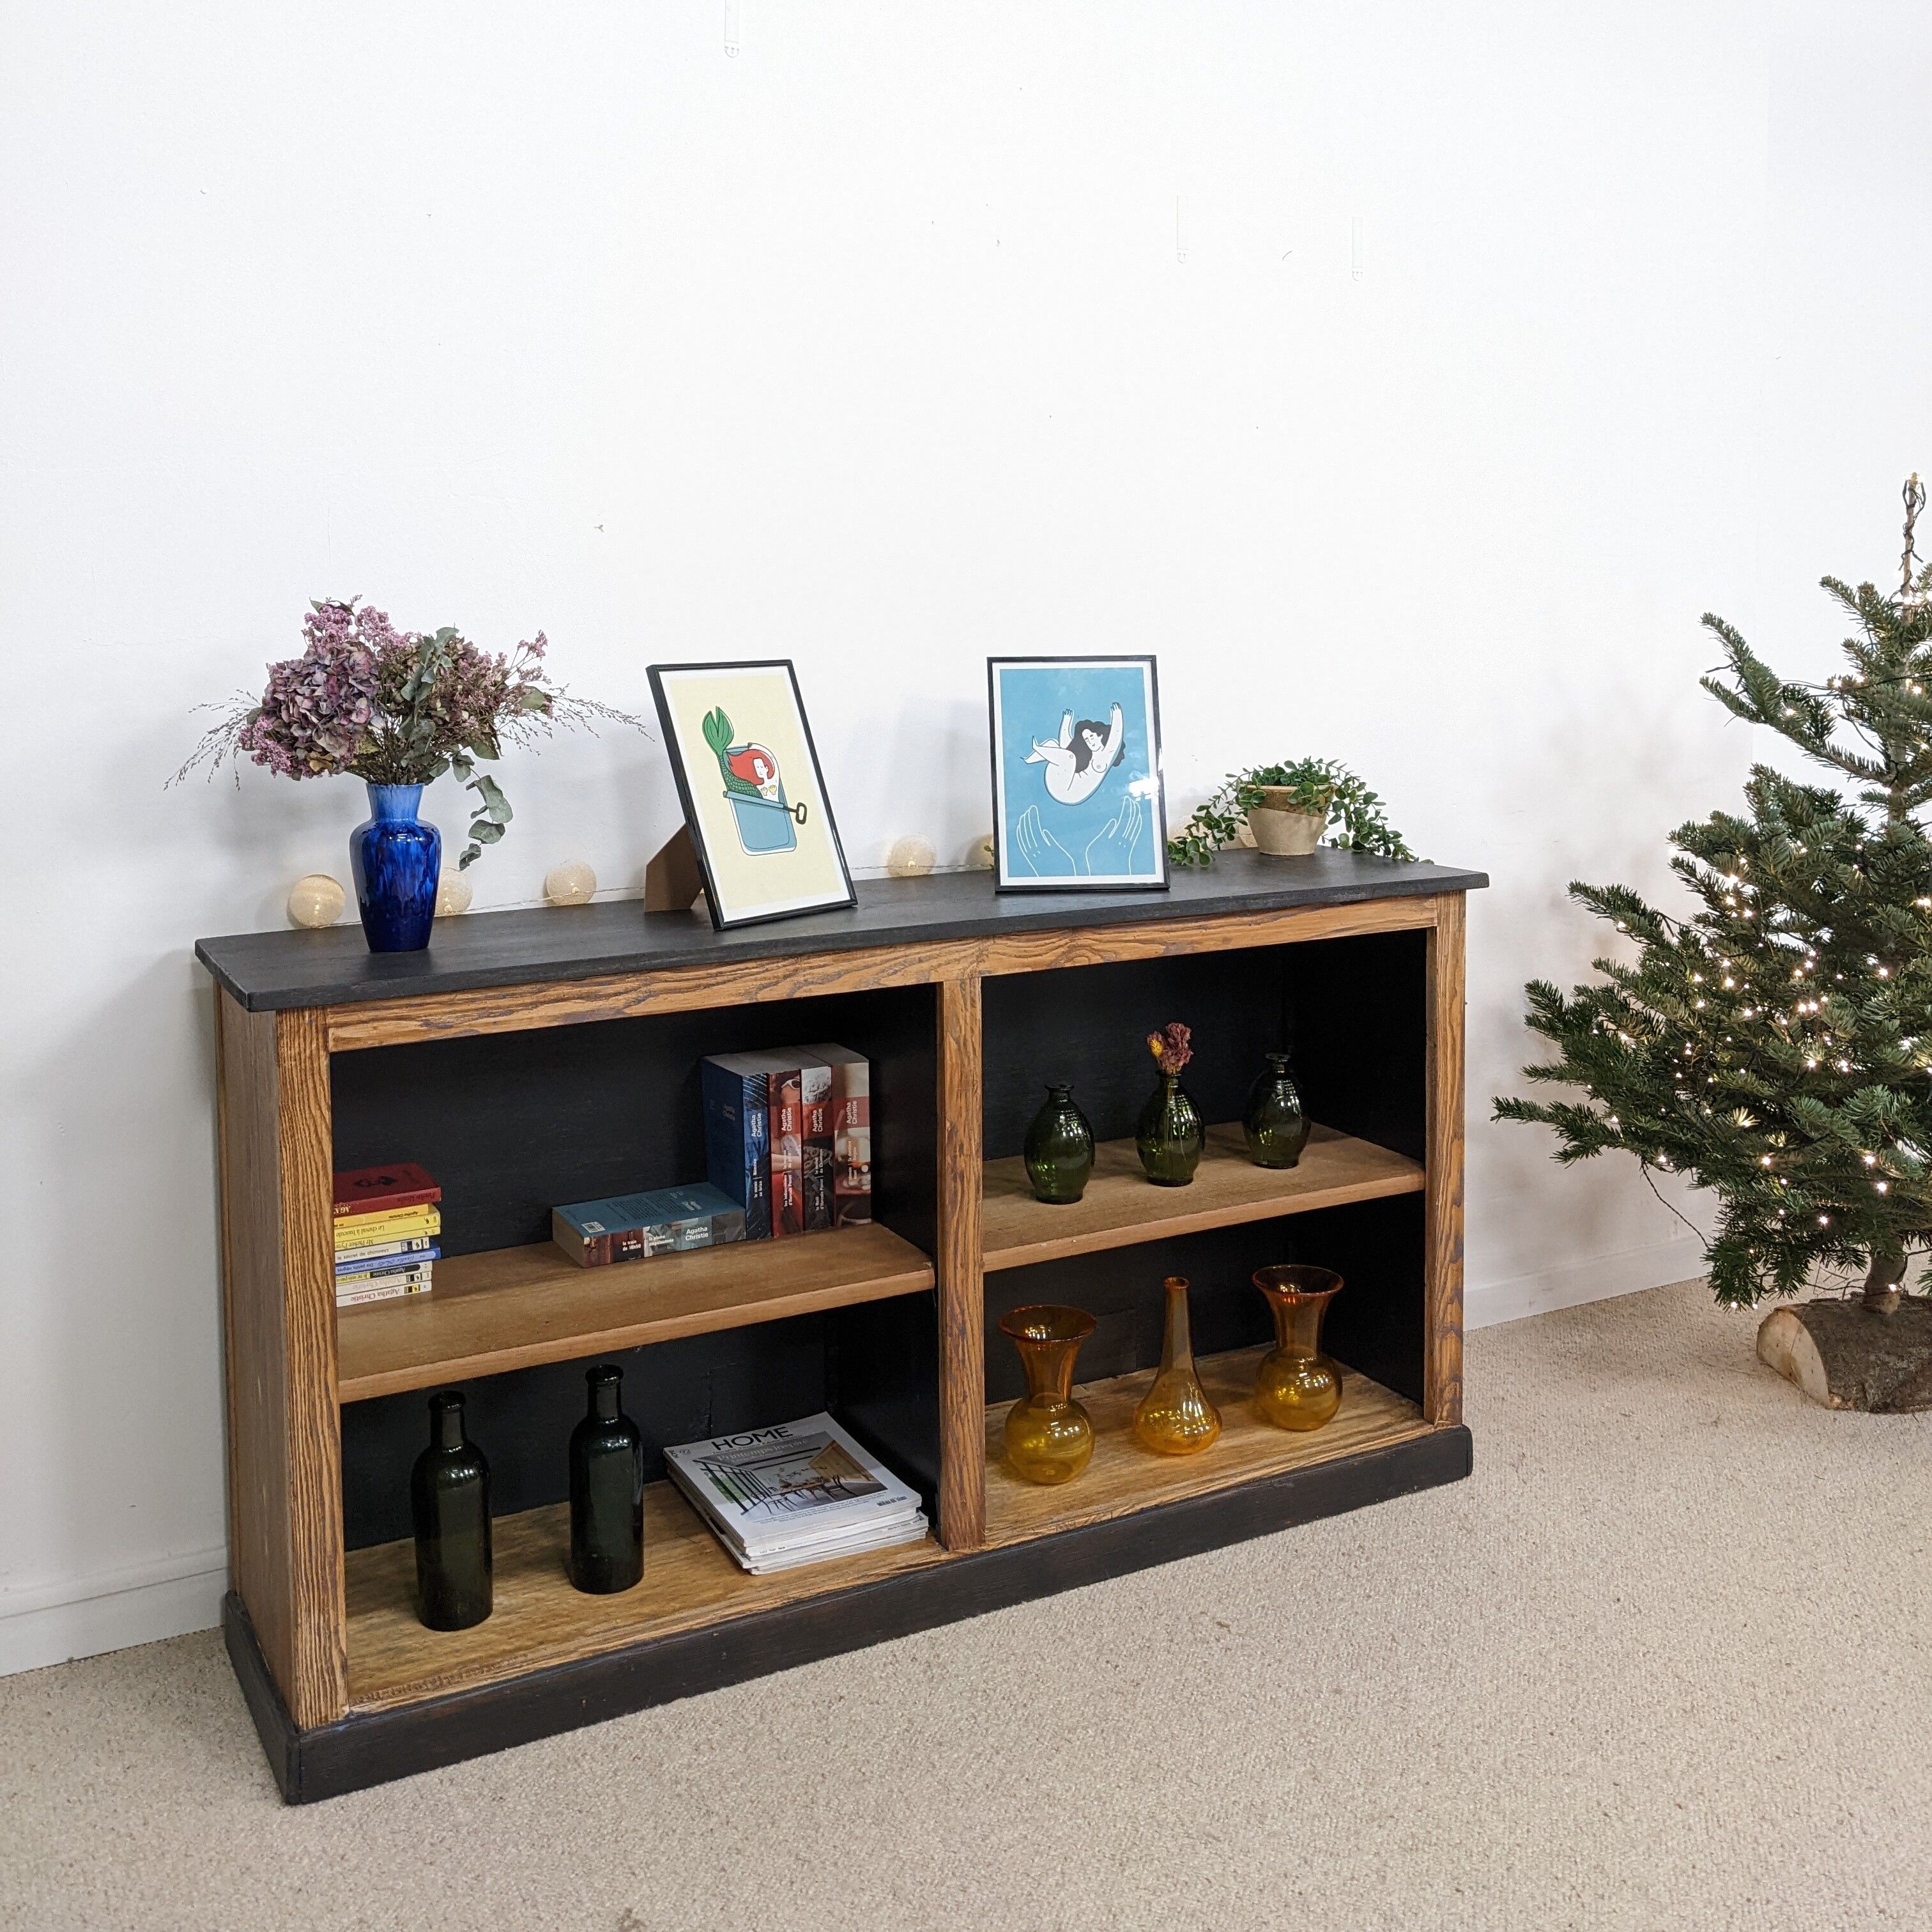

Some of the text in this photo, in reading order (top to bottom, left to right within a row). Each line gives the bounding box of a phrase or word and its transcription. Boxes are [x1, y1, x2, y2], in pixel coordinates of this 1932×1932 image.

[685, 1232, 709, 1241] Christie
[351, 1288, 400, 1301] Agatha Christie
[711, 1426, 793, 1451] HOME
